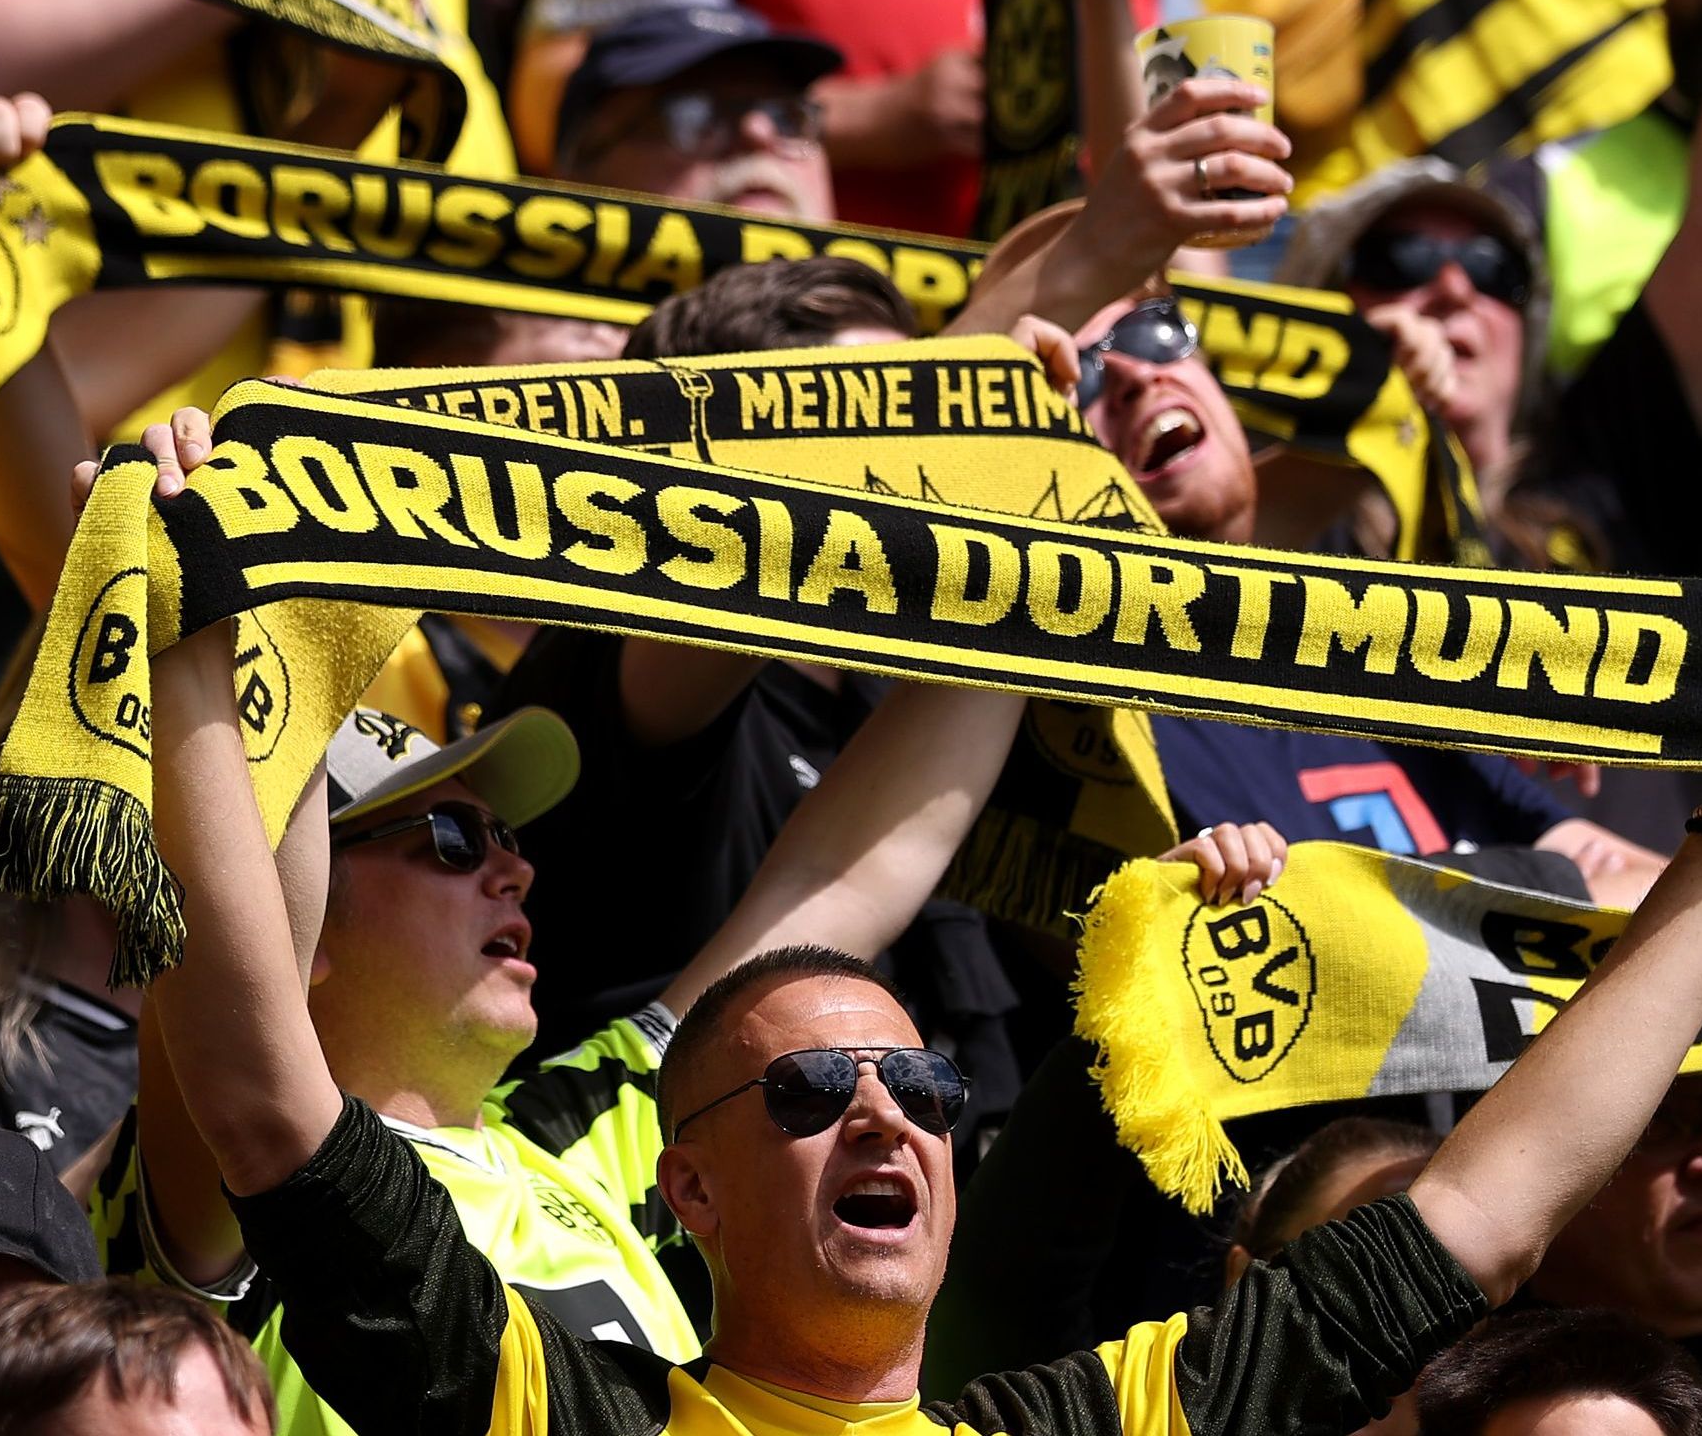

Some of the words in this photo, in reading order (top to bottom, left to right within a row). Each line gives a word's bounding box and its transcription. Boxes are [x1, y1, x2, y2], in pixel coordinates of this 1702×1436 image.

[95, 150, 703, 299] BORUSSIA
[738, 366, 915, 432] MEINE
[938, 365, 1094, 439] HEIM
[185, 434, 900, 617] BORUSSIA
[927, 522, 1689, 706] DORTMUND
[1205, 904, 1300, 1064] BVB
